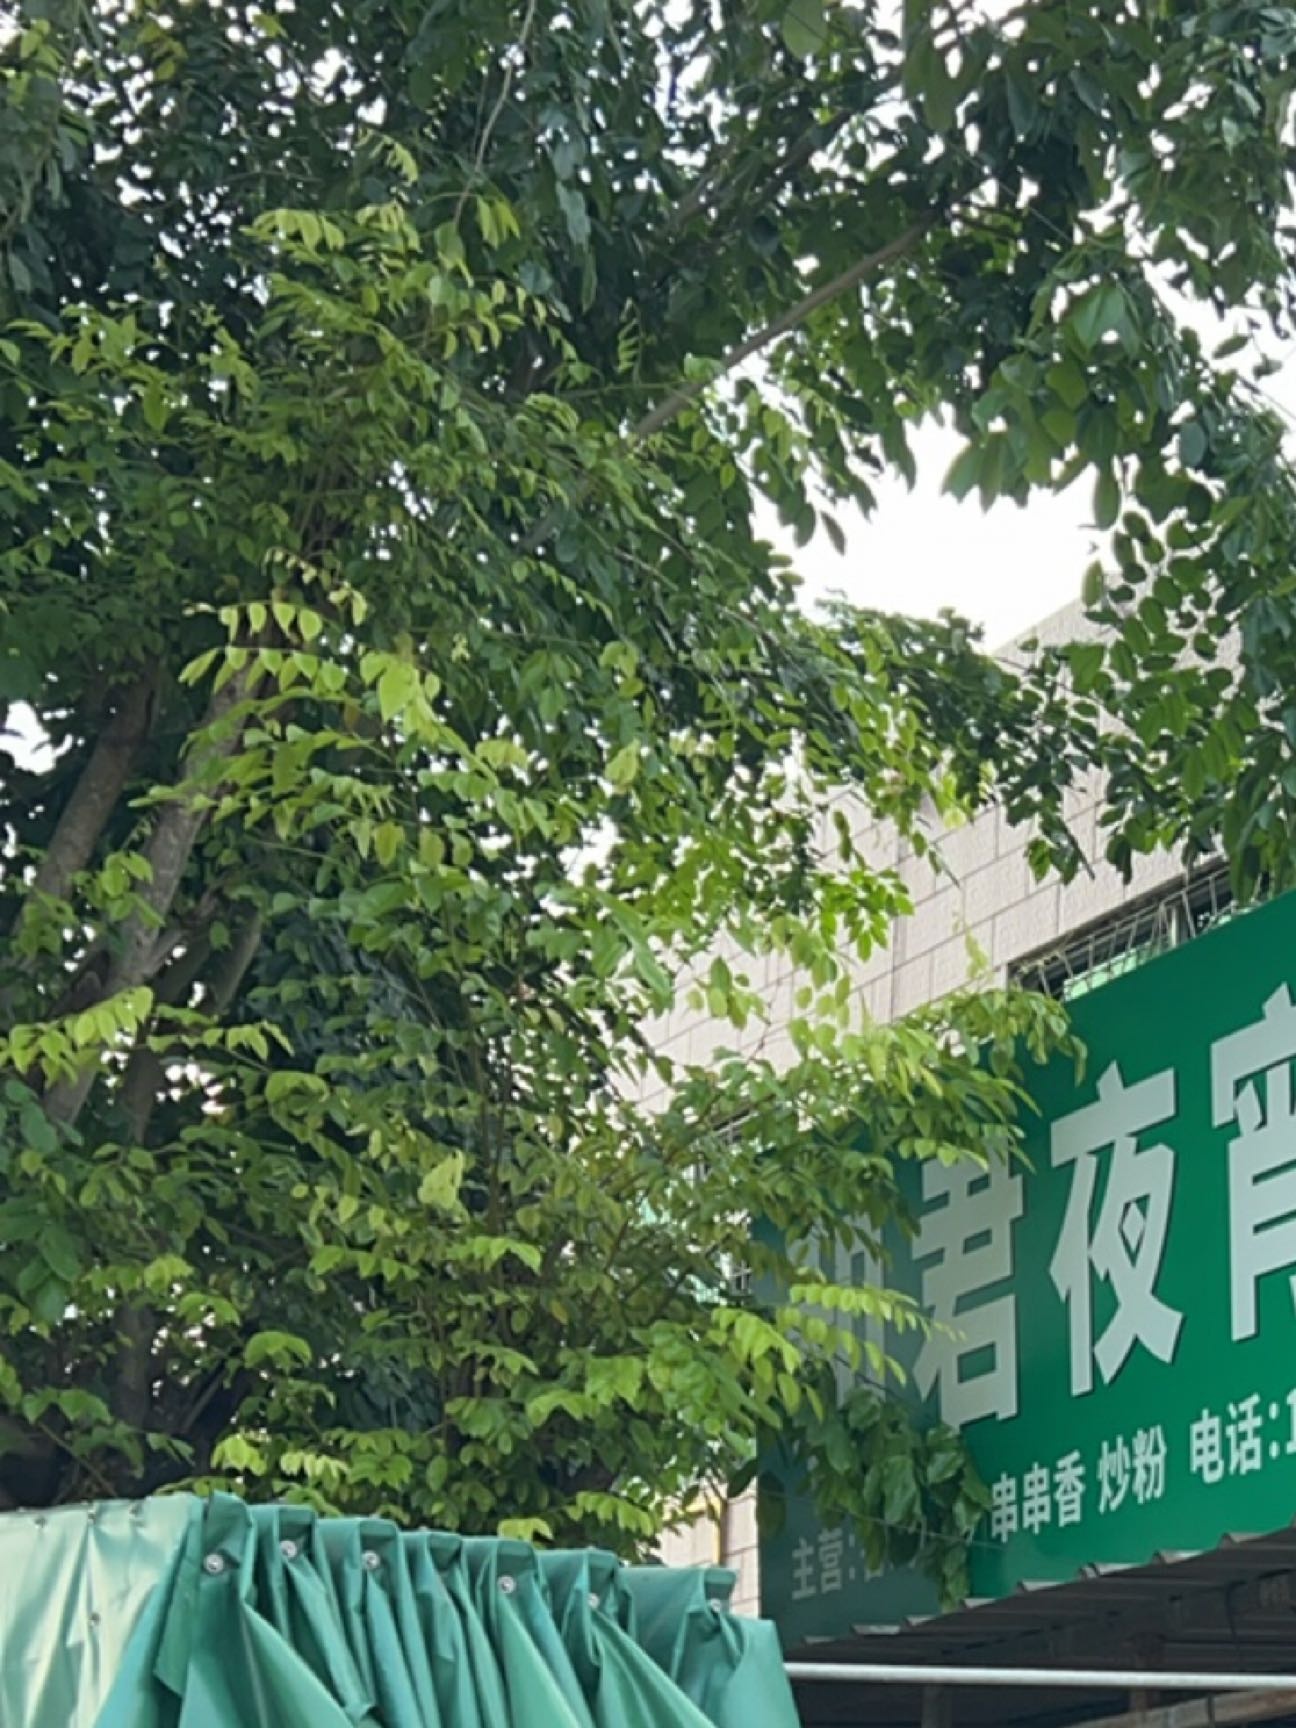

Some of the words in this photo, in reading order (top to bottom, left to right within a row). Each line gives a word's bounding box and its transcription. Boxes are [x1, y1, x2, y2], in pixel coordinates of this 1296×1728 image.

[990, 1449, 1087, 1543] 串串香
[1096, 1424, 1167, 1514] 炒粉
